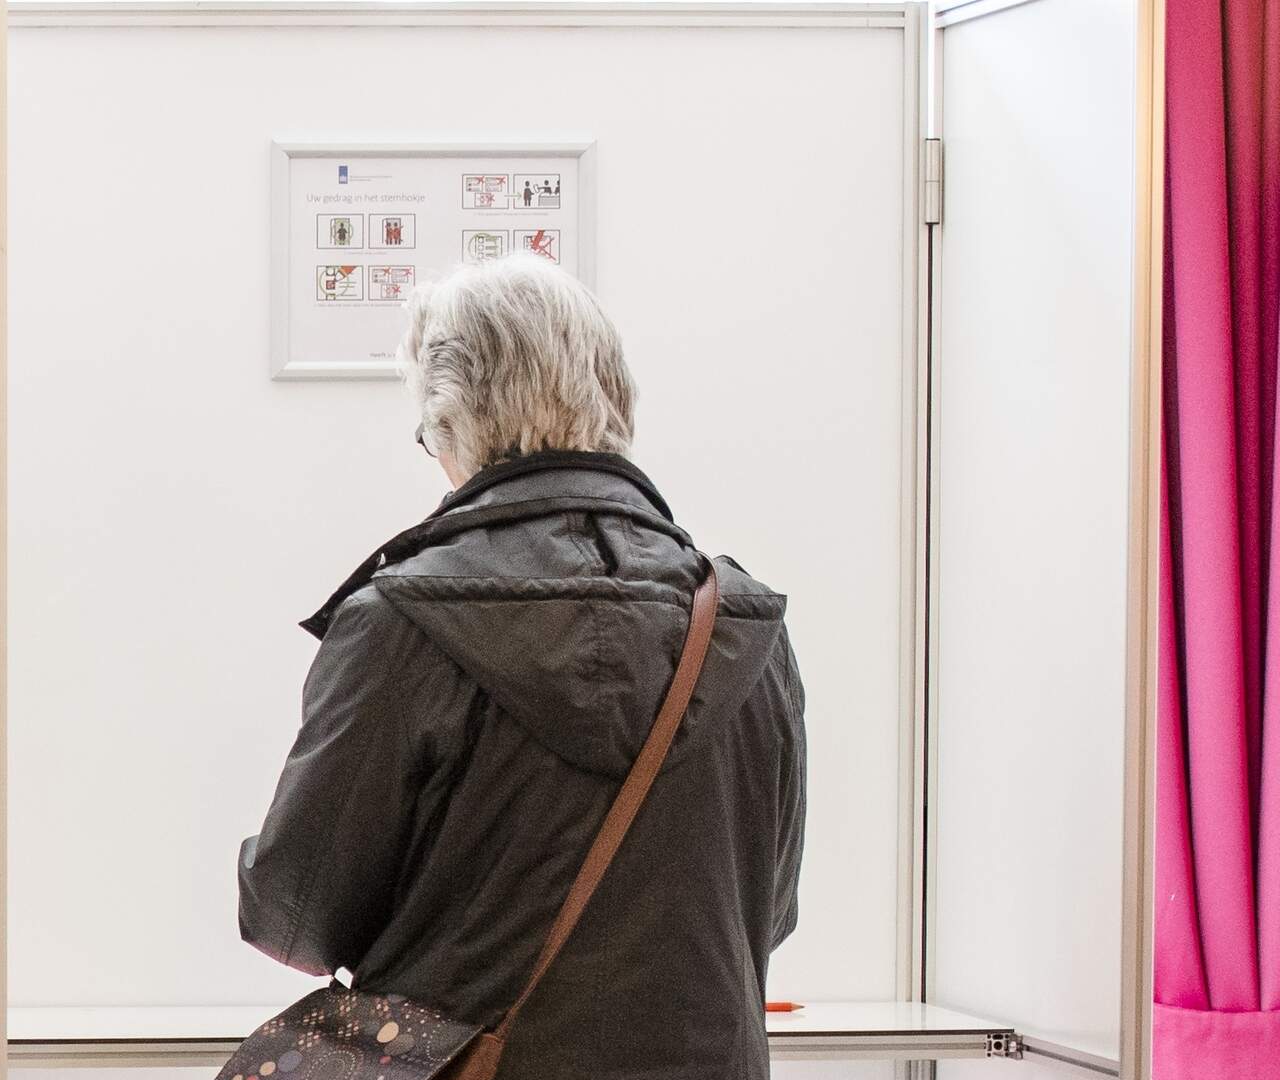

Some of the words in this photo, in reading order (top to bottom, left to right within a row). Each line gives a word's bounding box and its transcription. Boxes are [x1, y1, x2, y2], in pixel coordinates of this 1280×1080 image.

[306, 193, 321, 203] Uw
[322, 193, 353, 204] gedrag
[354, 193, 362, 203] in
[364, 193, 378, 203] het
[380, 193, 426, 204] stemhokje
